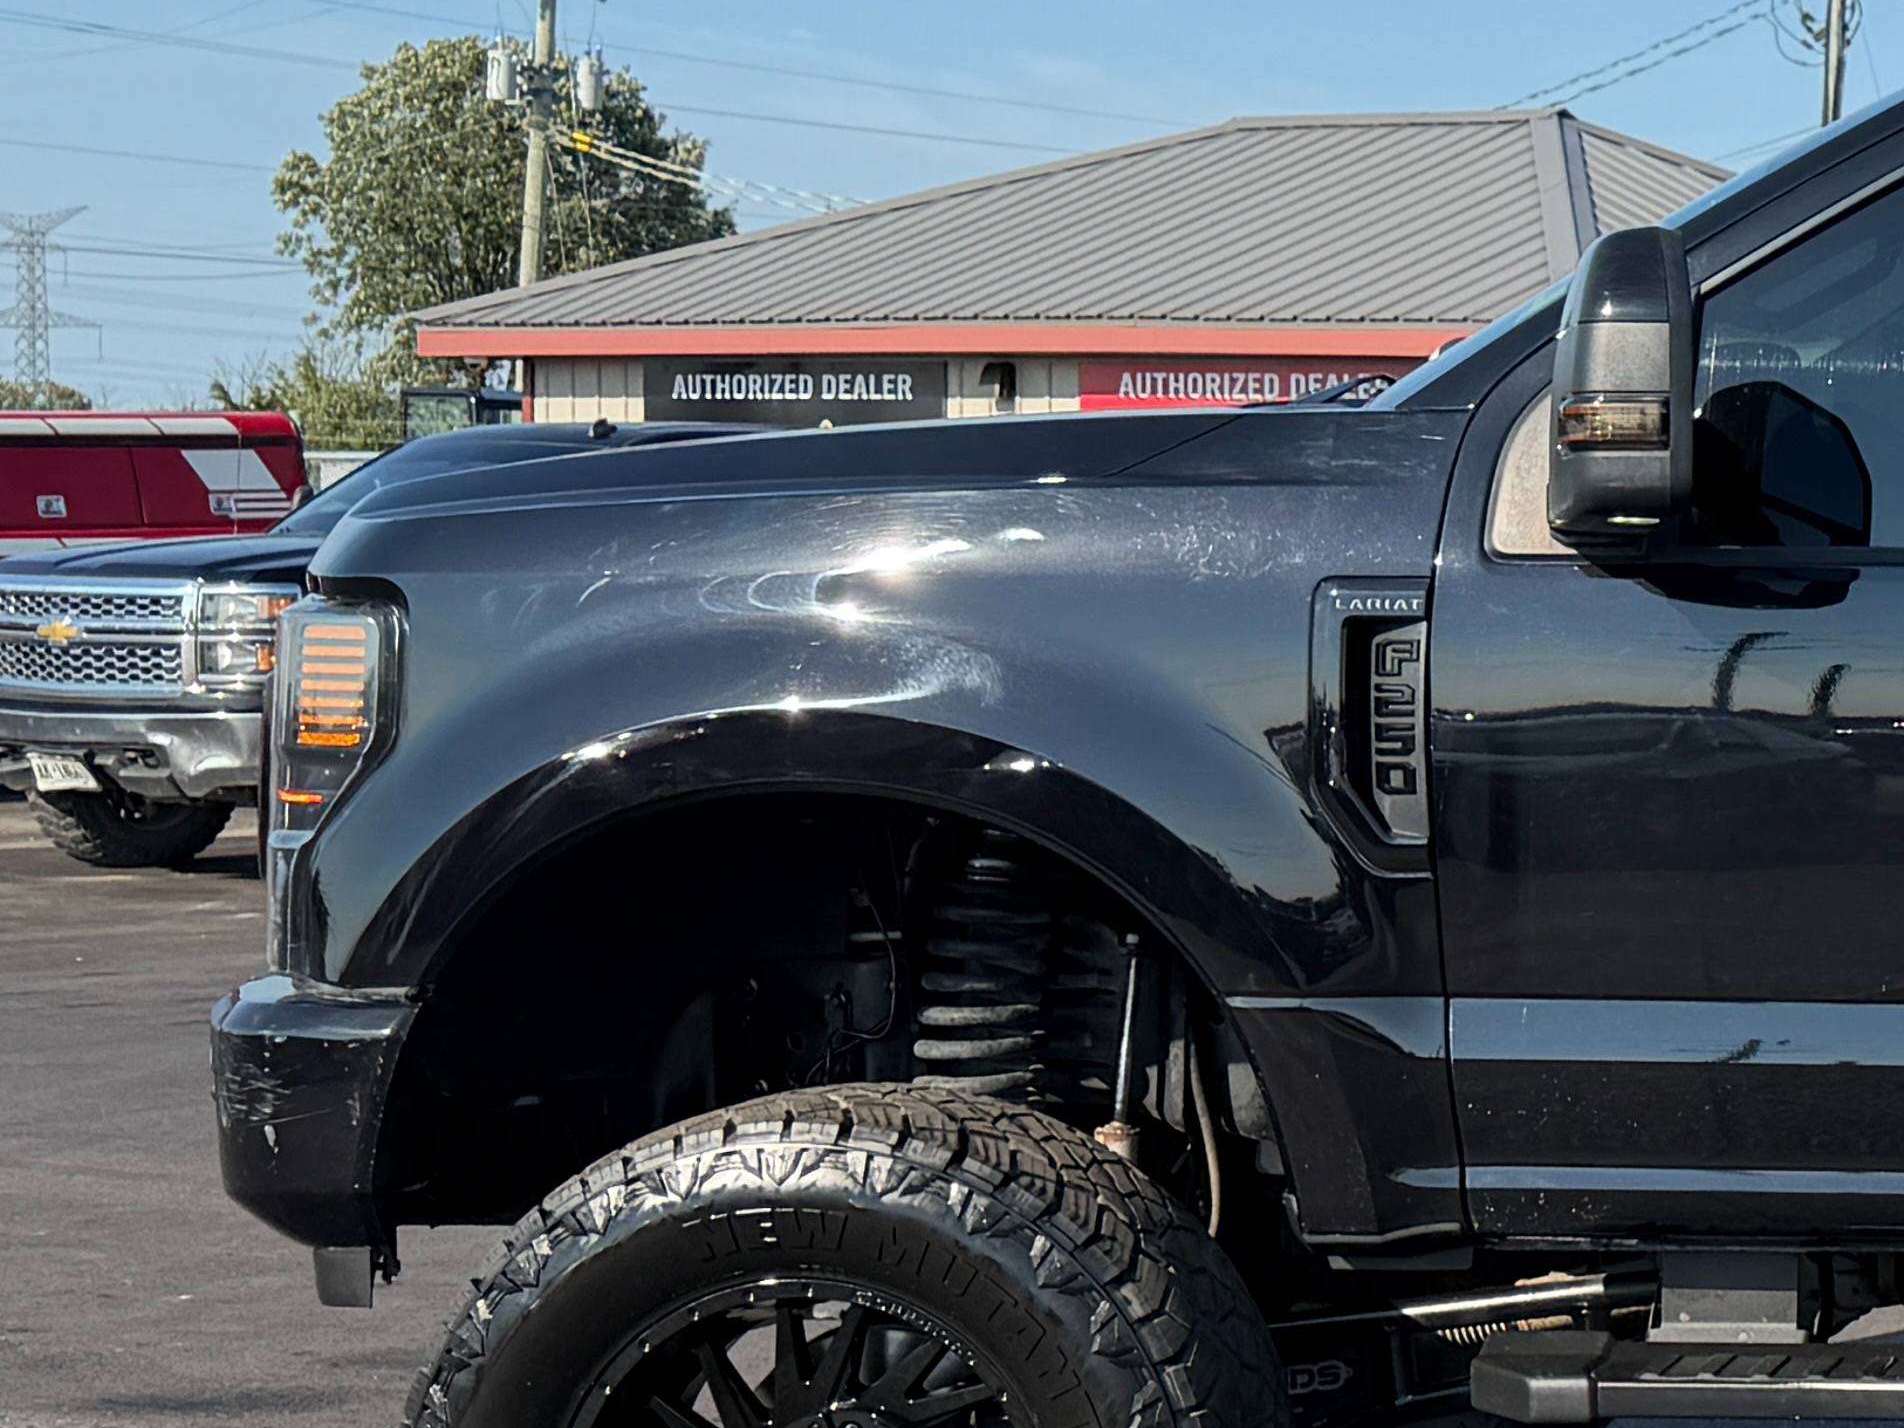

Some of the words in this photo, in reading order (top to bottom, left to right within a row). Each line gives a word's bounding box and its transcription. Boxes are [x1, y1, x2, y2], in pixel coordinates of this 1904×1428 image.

[671, 373, 813, 401] AUTHORIZED
[820, 373, 913, 401] DEALER
[1117, 371, 1279, 401] AUTHORIZED
[1334, 598, 1425, 611] LARIAT
